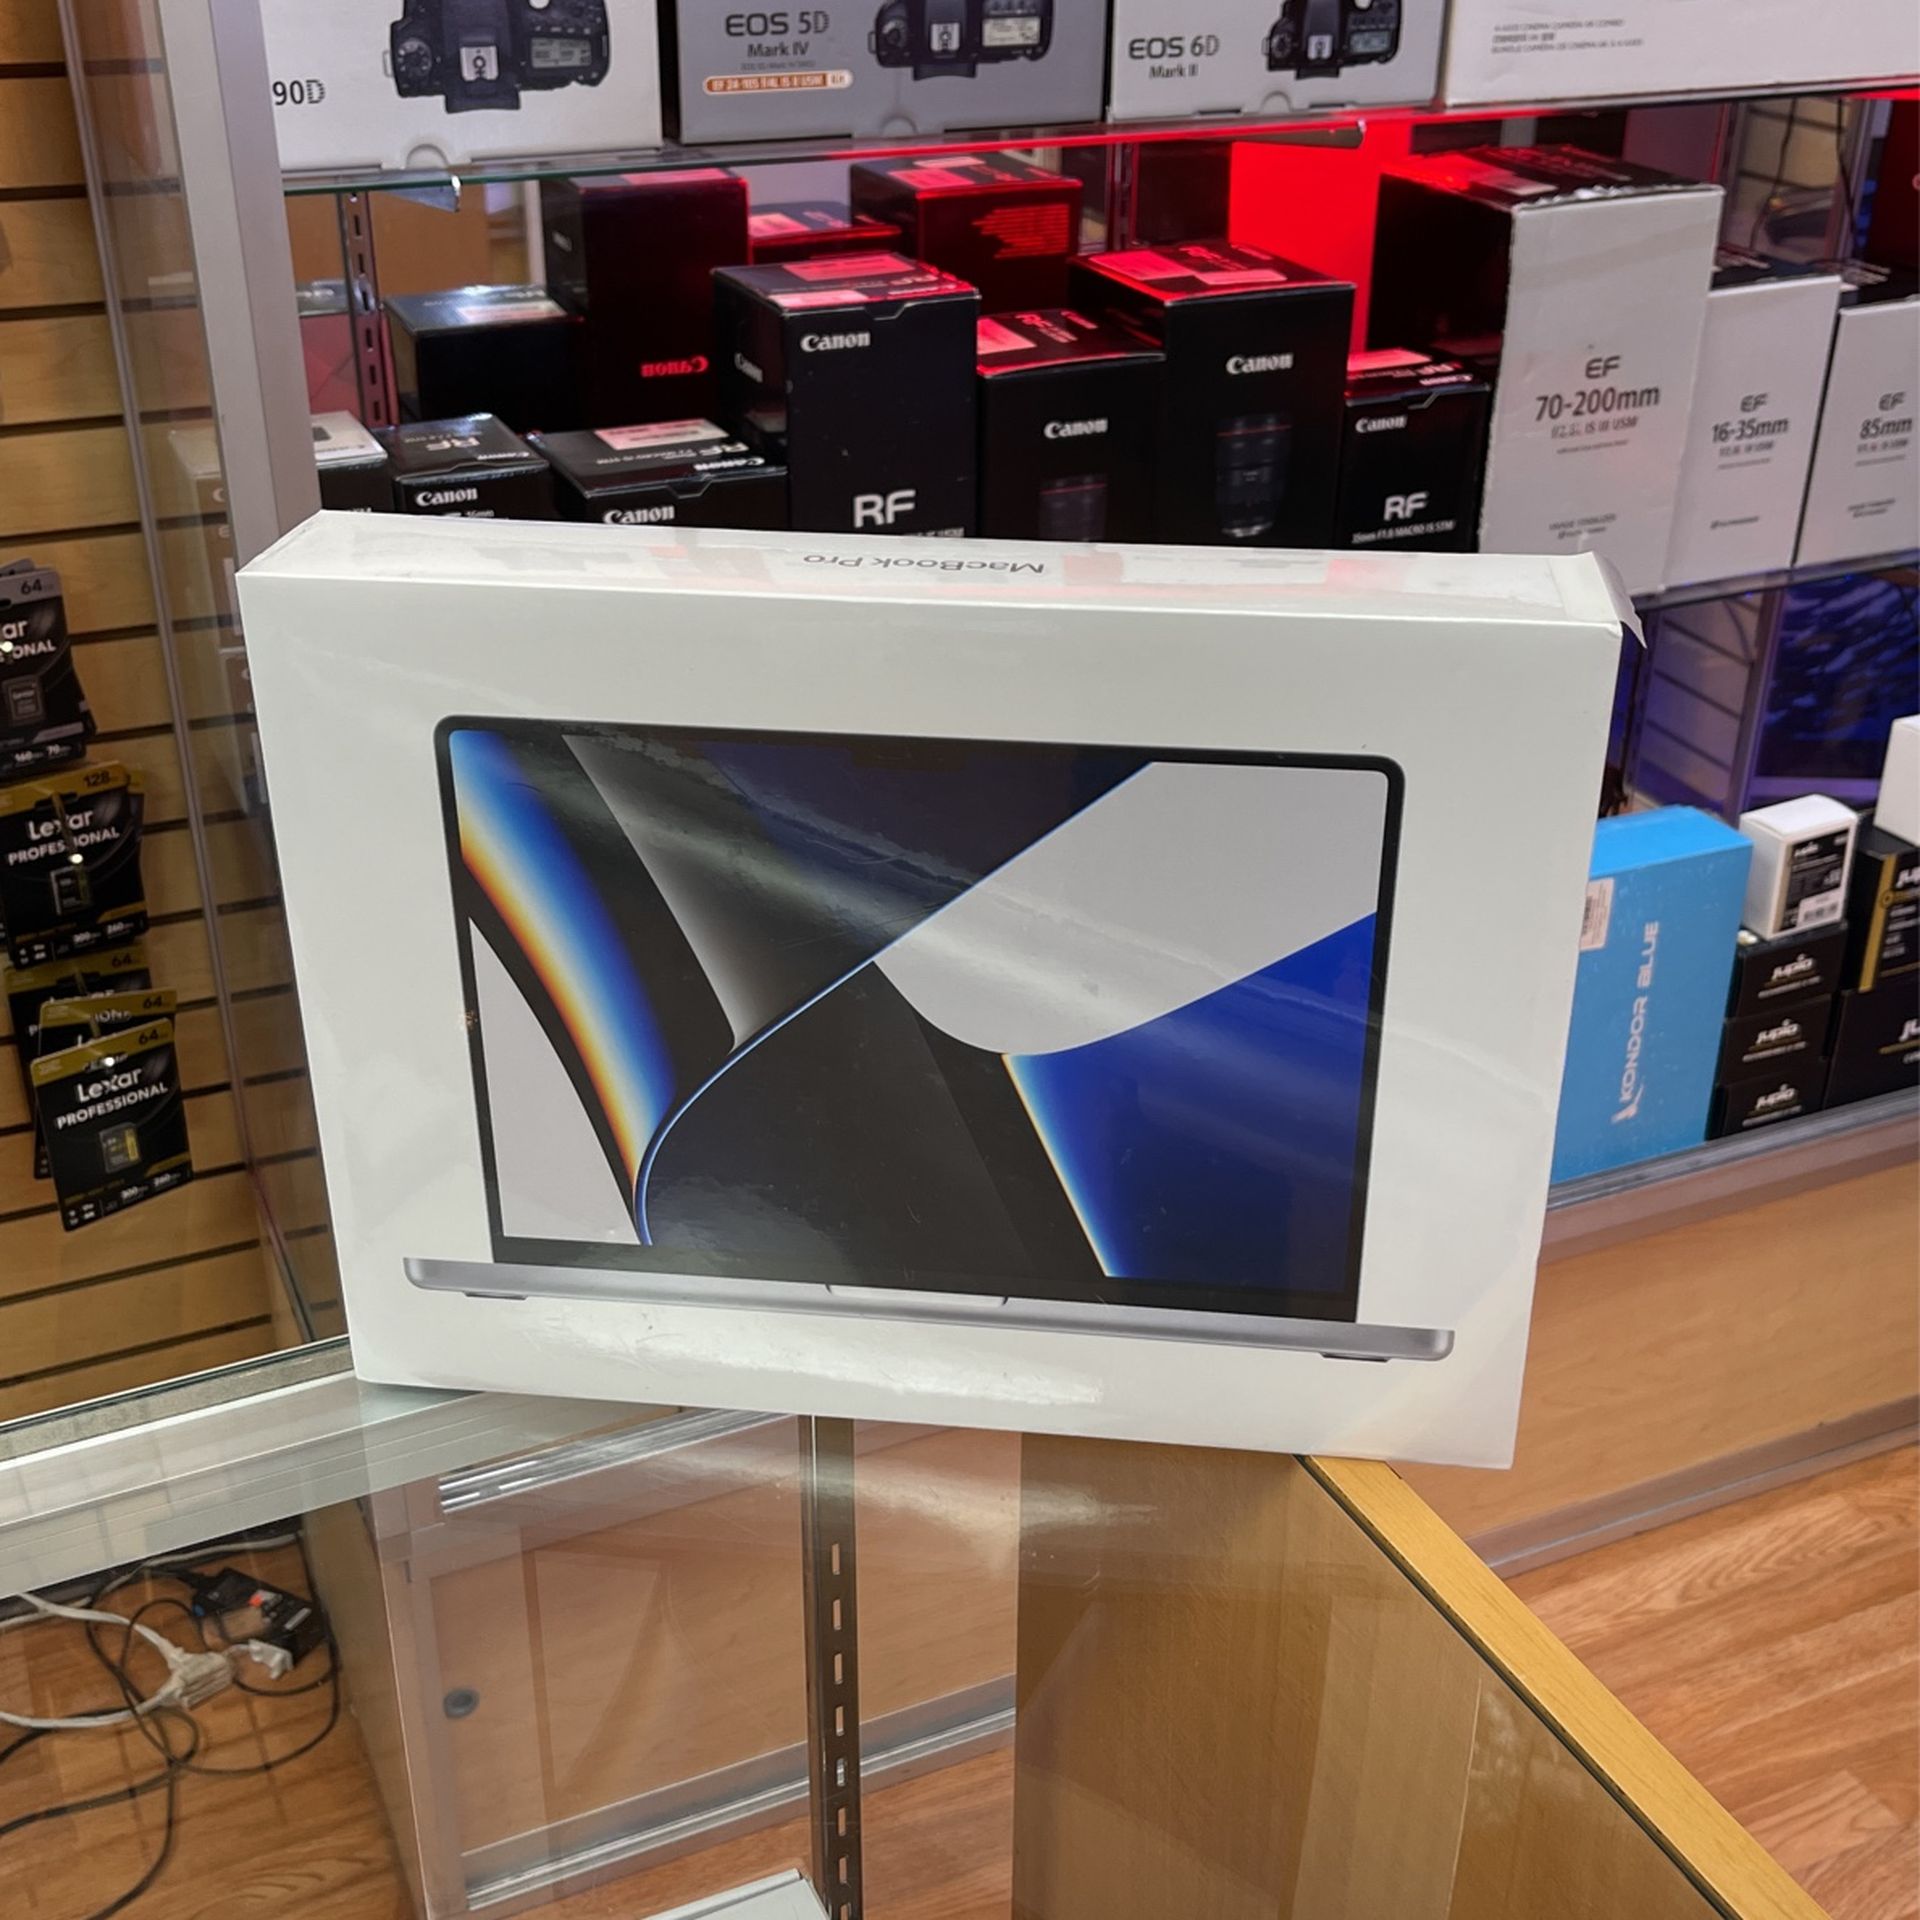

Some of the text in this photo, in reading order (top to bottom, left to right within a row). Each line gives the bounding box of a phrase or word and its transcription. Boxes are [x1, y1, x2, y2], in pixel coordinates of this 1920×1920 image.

[725, 10, 830, 36] EOS 5D
[747, 41, 810, 58] Mark IV
[1129, 34, 1220, 60] EOS 6D
[1149, 64, 1184, 79] Mark
[273, 79, 325, 106] 90D
[800, 331, 871, 352] Canon
[1226, 352, 1293, 375] Canon
[1585, 355, 1620, 379] EF
[1535, 386, 1659, 421] 70-200mm
[1740, 393, 1767, 412] EF
[1879, 391, 1905, 411] EF
[1044, 418, 1108, 439] Canon
[1355, 415, 1408, 433] Canon
[1712, 418, 1788, 443] 16-35mm
[1860, 417, 1912, 439] 85mm
[416, 488, 478, 507] Canon
[1384, 491, 1429, 521] RF
[603, 505, 675, 524] Canon
[854, 489, 916, 529] RF
[803, 554, 1045, 574] MacBook Pro
[21, 579, 42, 595] 64
[84, 770, 110, 787] 128
[8, 827, 120, 866] PROFESIONAL
[112, 954, 132, 968] 64
[143, 995, 163, 1009] 64
[1619, 921, 1660, 1102] KONDOR BLUE
[138, 1029, 159, 1045] 64
[77, 1068, 142, 1102] Lexar
[56, 1082, 168, 1130] PROFESSIONAL
